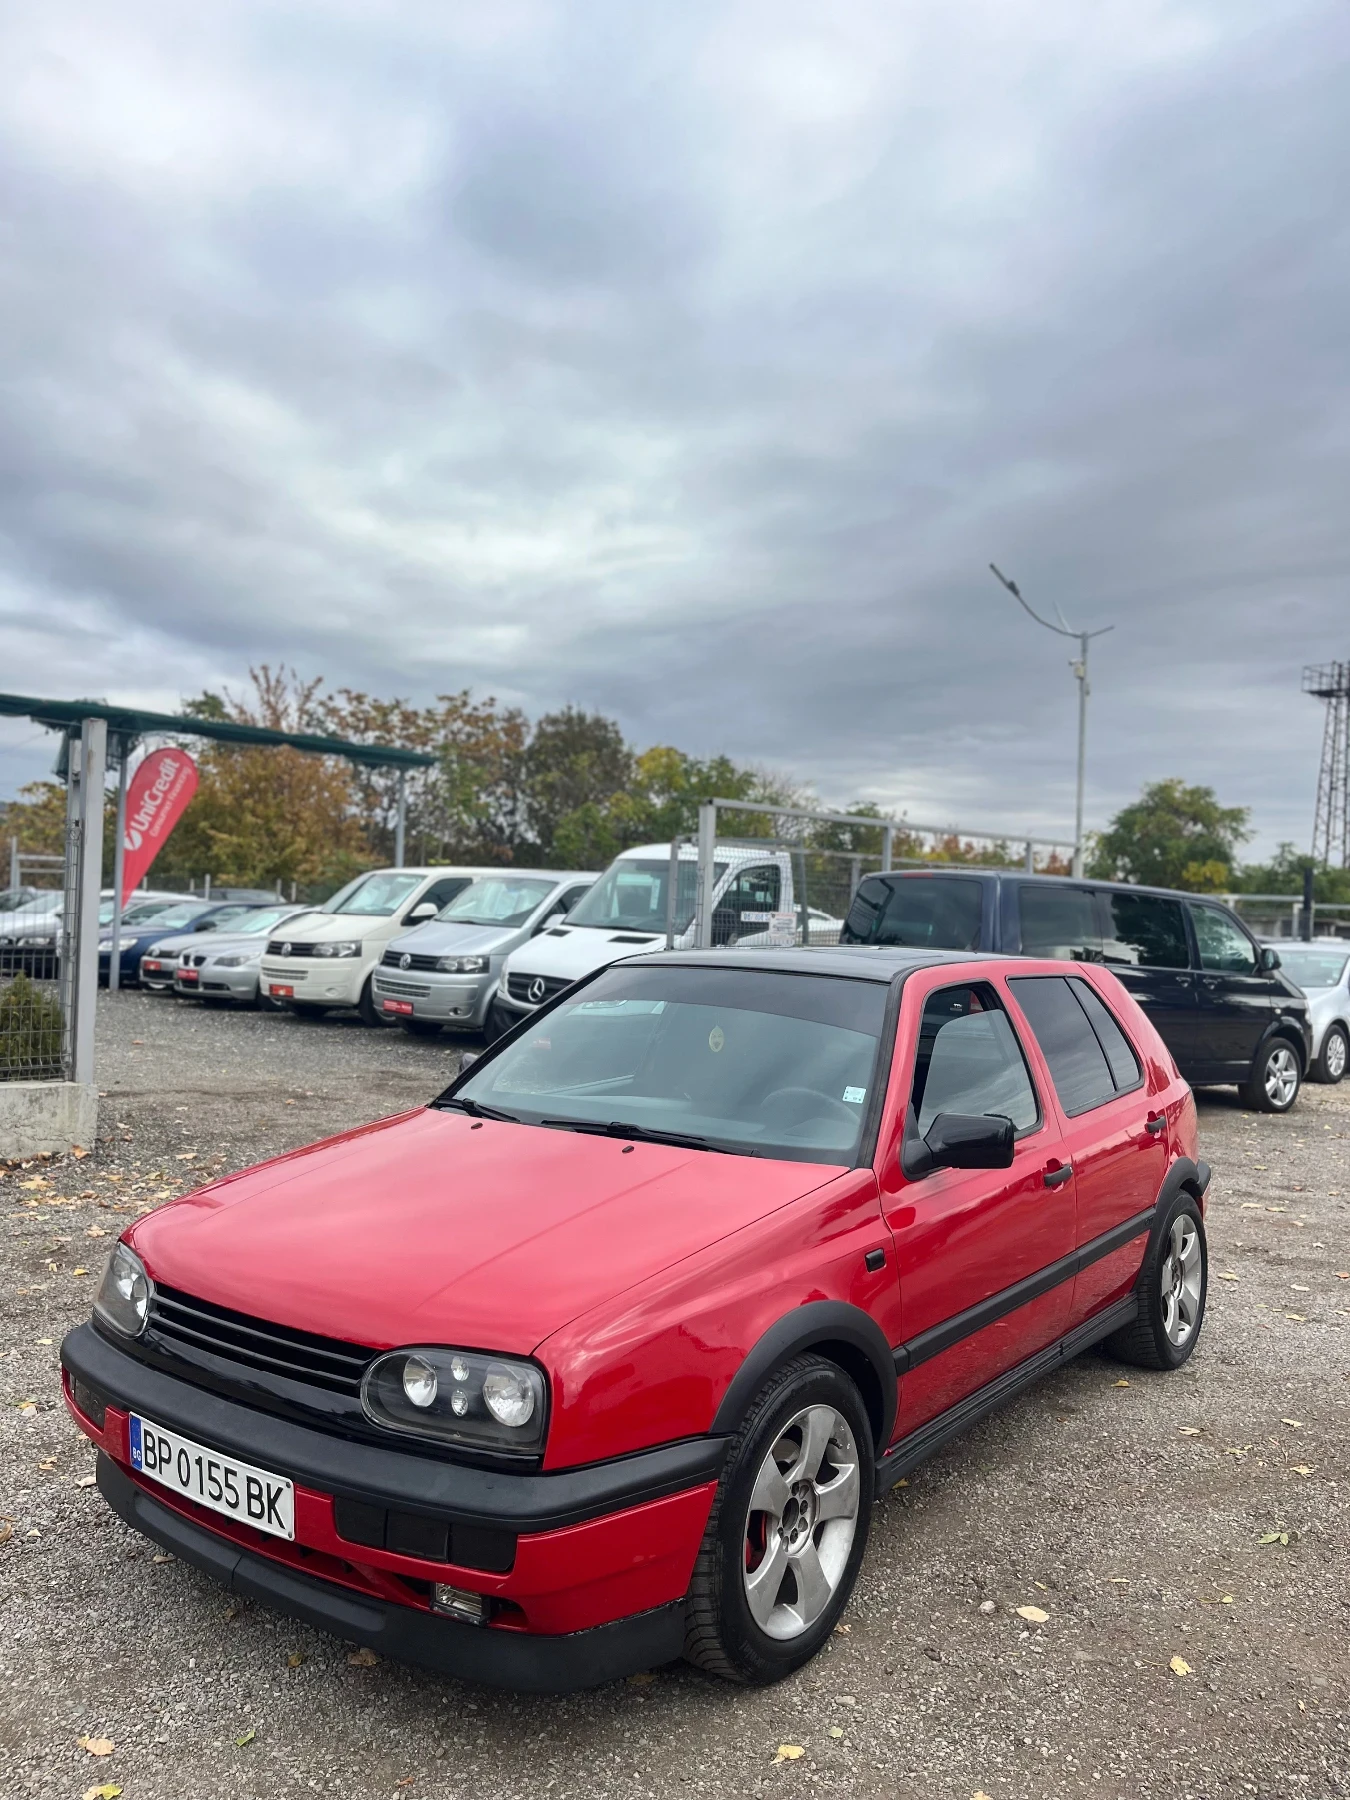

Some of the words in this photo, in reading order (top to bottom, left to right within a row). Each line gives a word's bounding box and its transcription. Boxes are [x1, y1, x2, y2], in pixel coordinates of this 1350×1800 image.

[131, 758, 180, 831] UniCredit
[132, 1448, 142, 1462] BG
[143, 1428, 172, 1475] BP
[177, 1447, 240, 1509] 0155
[246, 1475, 286, 1530] BK
